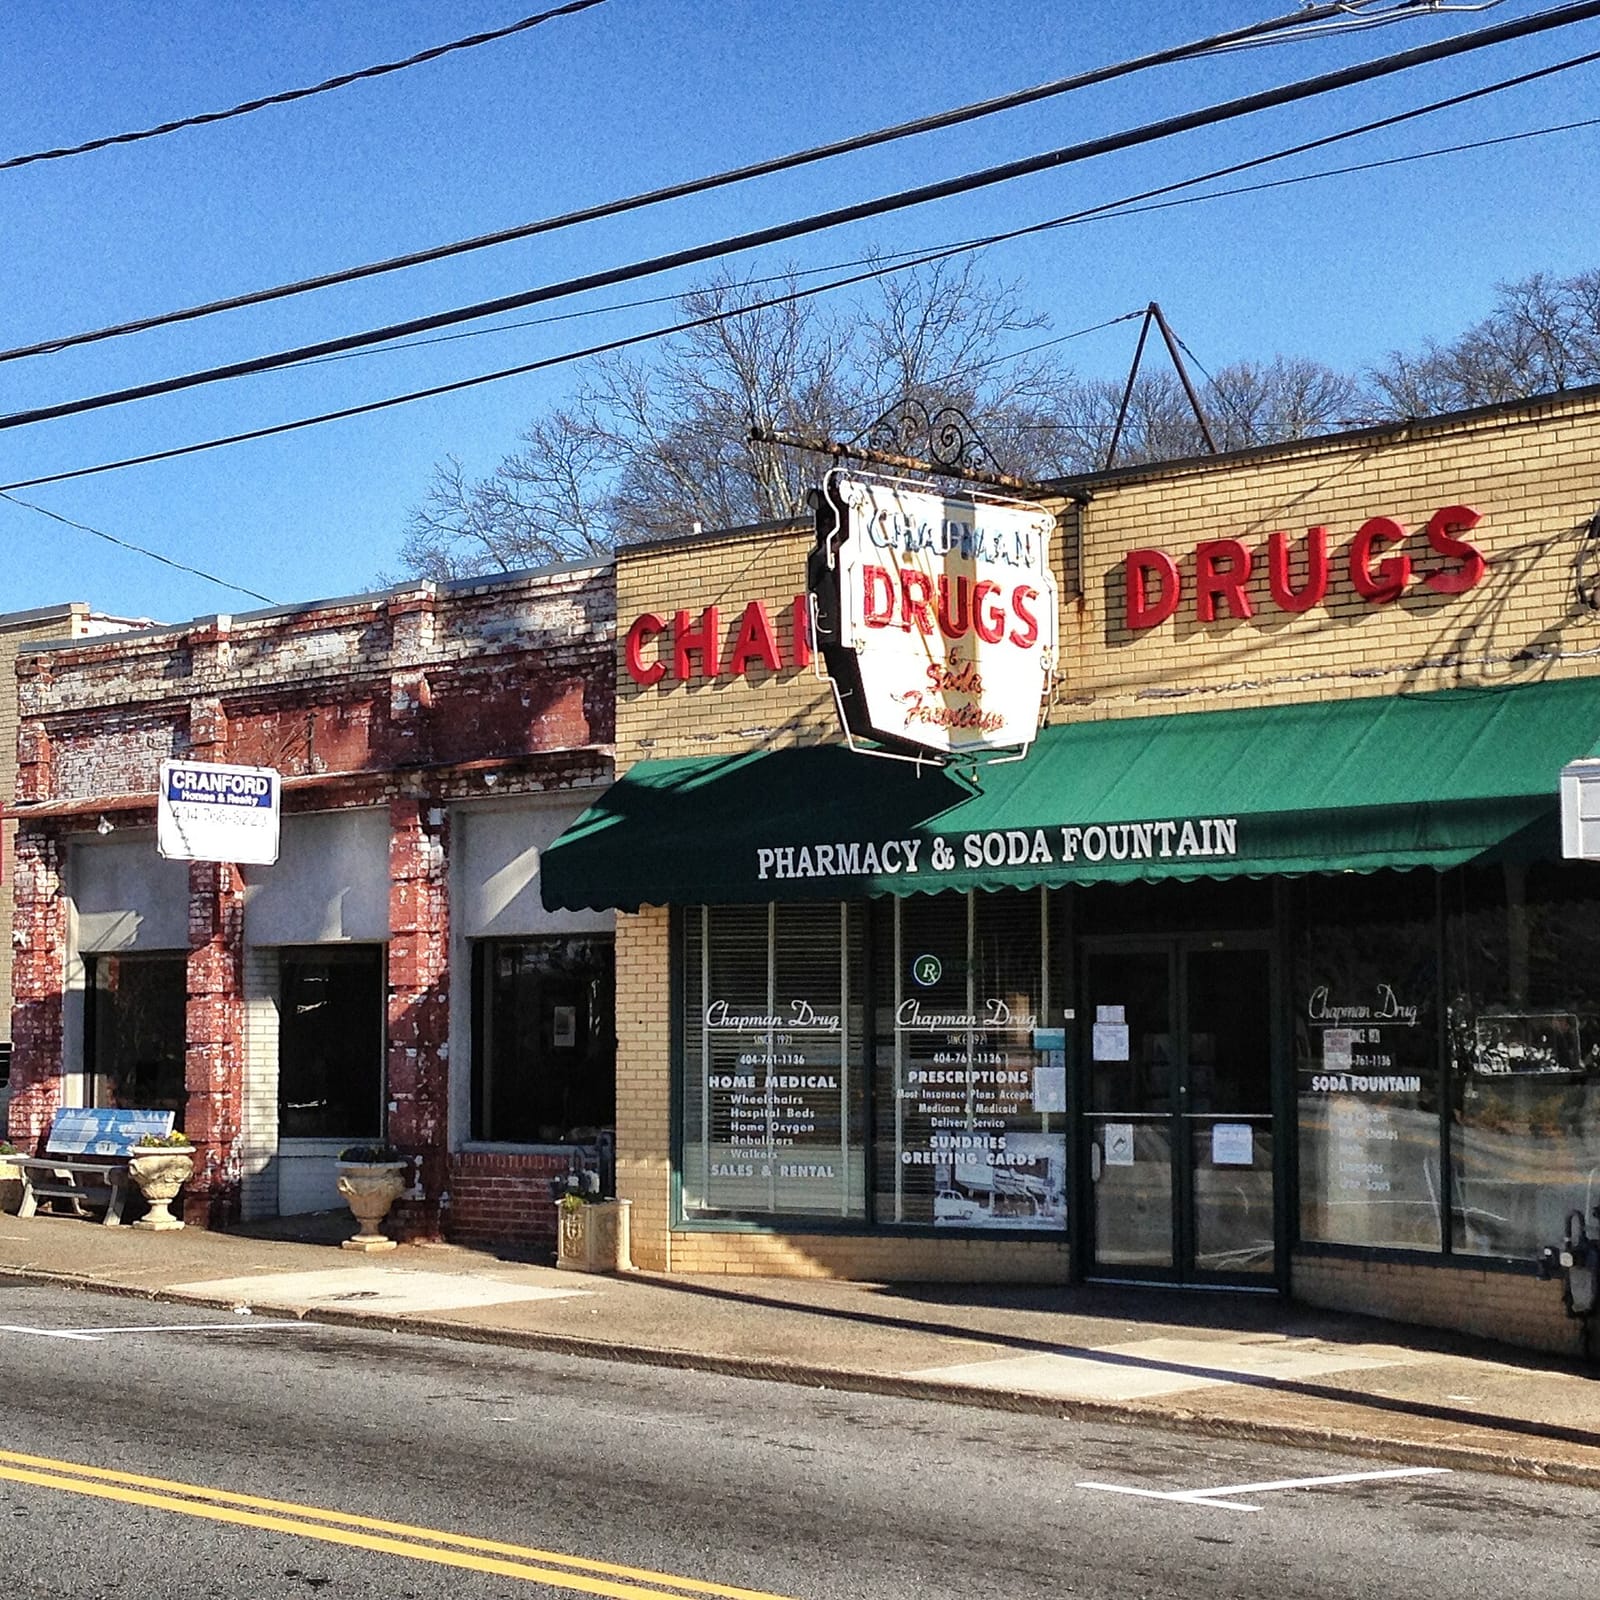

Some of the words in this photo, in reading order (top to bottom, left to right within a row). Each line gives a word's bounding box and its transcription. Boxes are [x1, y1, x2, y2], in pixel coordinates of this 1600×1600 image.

[1126, 505, 1486, 630] DRUGS
[863, 563, 1040, 650] DRUGS
[925, 661, 985, 694] Soda
[172, 771, 268, 795] CRANFORD
[217, 793, 227, 804] &
[756, 838, 921, 880] PHARMACY
[931, 836, 955, 870] &
[964, 828, 1053, 869] SODA
[1061, 818, 1238, 863] FOUNTAIN
[1309, 985, 1371, 1028] Chapman
[1374, 984, 1418, 1028] Drug
[705, 1000, 783, 1032] Chapman
[788, 1000, 840, 1032] Drug
[895, 998, 977, 1032] Chapman
[983, 998, 1038, 1032] Drug
[740, 1054, 805, 1065] 404-761-1136
[933, 1052, 1002, 1064] 404-761-1136
[709, 1076, 756, 1089] HOME
[765, 1076, 838, 1089] MEDICAL
[908, 1071, 1029, 1084] PRESCRIPTIONS
[1312, 1075, 1348, 1092] SODA
[1352, 1076, 1421, 1093] FOUNTAIN
[731, 1094, 803, 1105] Wheelchairs
[897, 1089, 918, 1099] Most
[922, 1089, 966, 1099] Insurance
[971, 1089, 995, 1100] Plans
[731, 1108, 780, 1119] Hospital
[787, 1108, 815, 1119] Beds
[919, 1103, 960, 1113] Medicare
[964, 1104, 971, 1113] &
[975, 1103, 1018, 1113] Medicaid
[731, 1122, 764, 1132] Home
[770, 1122, 815, 1134] Oxygen
[931, 1117, 968, 1129] Delivery
[973, 1117, 1006, 1128] Service
[731, 1135, 794, 1146] Nebulizers
[930, 1136, 1007, 1149] SUNDRIES
[731, 1148, 778, 1159] Walkers
[901, 1151, 977, 1164] GREETING
[986, 1153, 1036, 1166] CARDS
[711, 1164, 753, 1176] SALES
[761, 1164, 772, 1177] &
[780, 1165, 835, 1178] RENTAL
